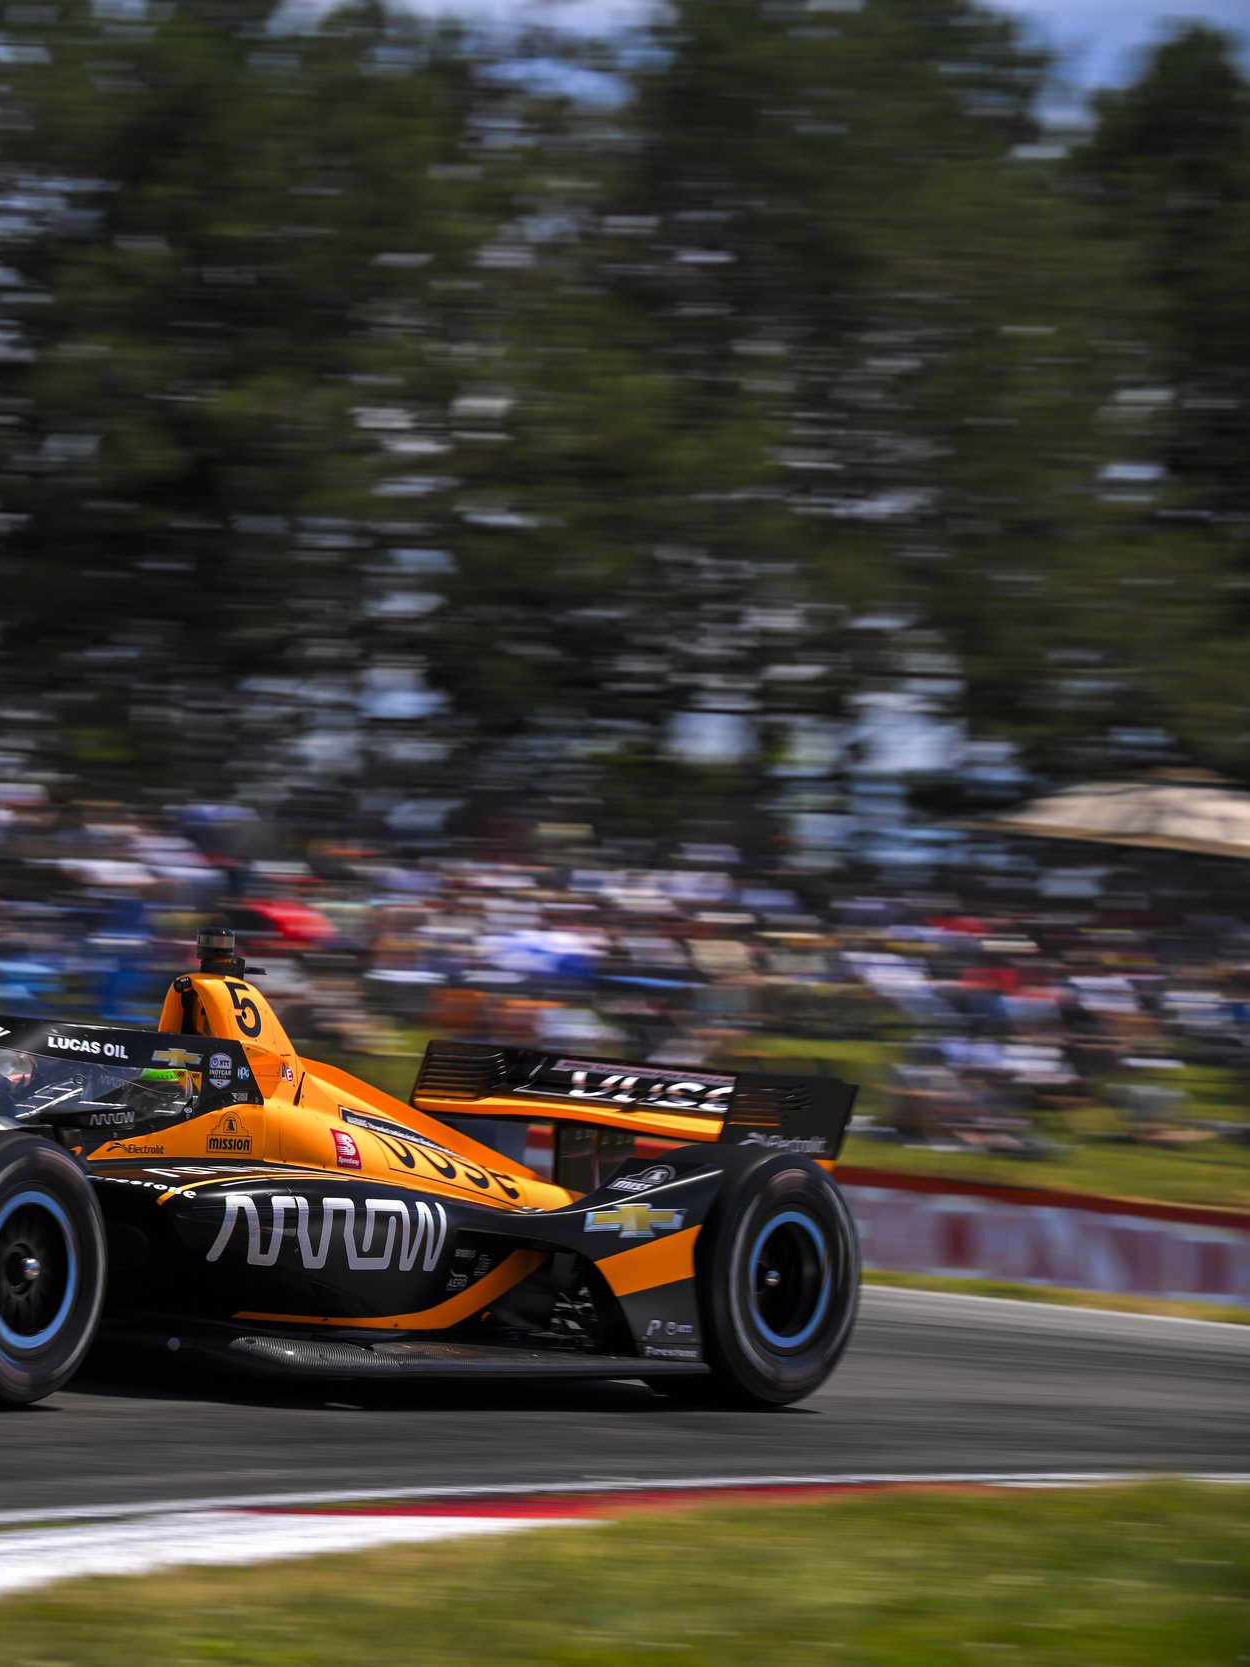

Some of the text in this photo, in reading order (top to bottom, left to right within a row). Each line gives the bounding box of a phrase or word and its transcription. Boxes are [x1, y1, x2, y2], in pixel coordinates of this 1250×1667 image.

[224, 981, 262, 1038] 5
[47, 1036, 129, 1060] LUCAS OIL
[209, 1068, 232, 1077] INDYCAR
[237, 1066, 250, 1079] PPG
[89, 1111, 135, 1126] ARROW
[128, 1144, 165, 1155] Electrolit
[209, 1138, 250, 1151] MISSION
[338, 1156, 360, 1167] Speedway
[206, 1195, 448, 1272] ARROW
